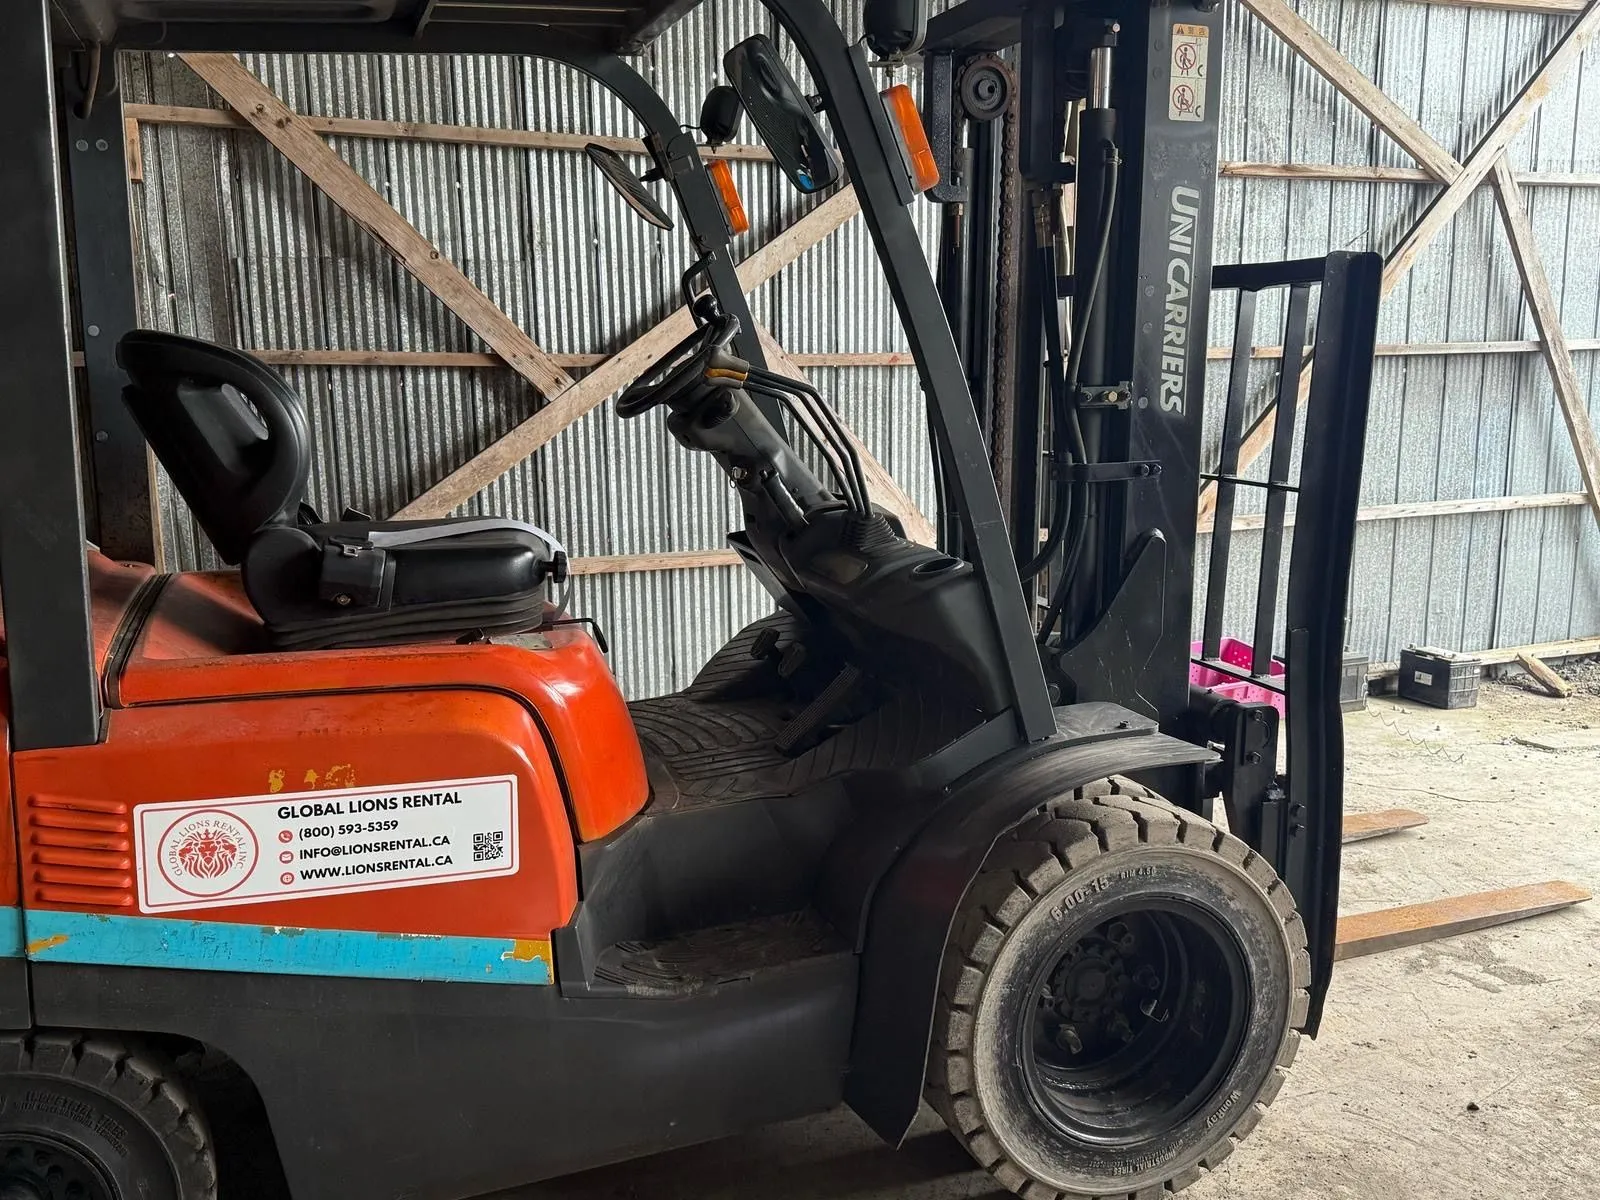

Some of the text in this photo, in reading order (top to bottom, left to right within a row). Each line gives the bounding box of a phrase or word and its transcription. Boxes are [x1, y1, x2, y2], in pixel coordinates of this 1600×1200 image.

[277, 791, 462, 820] GLOBAL LIONS RENTAL
[298, 819, 399, 842] (800) 593-5359
[168, 838, 183, 877] GLOBAL
[179, 819, 210, 838] LIONS
[213, 819, 247, 850] RENTAL
[299, 836, 451, 861] INFO@LIONSRENTAL.CA
[299, 856, 453, 880] WWW.LIONSRENTAL.CA
[1050, 875, 1110, 921] 6.00-15
[1205, 1089, 1241, 1130] WonRay
[1113, 1148, 1177, 1176] INDUSTRIAL TIRES
